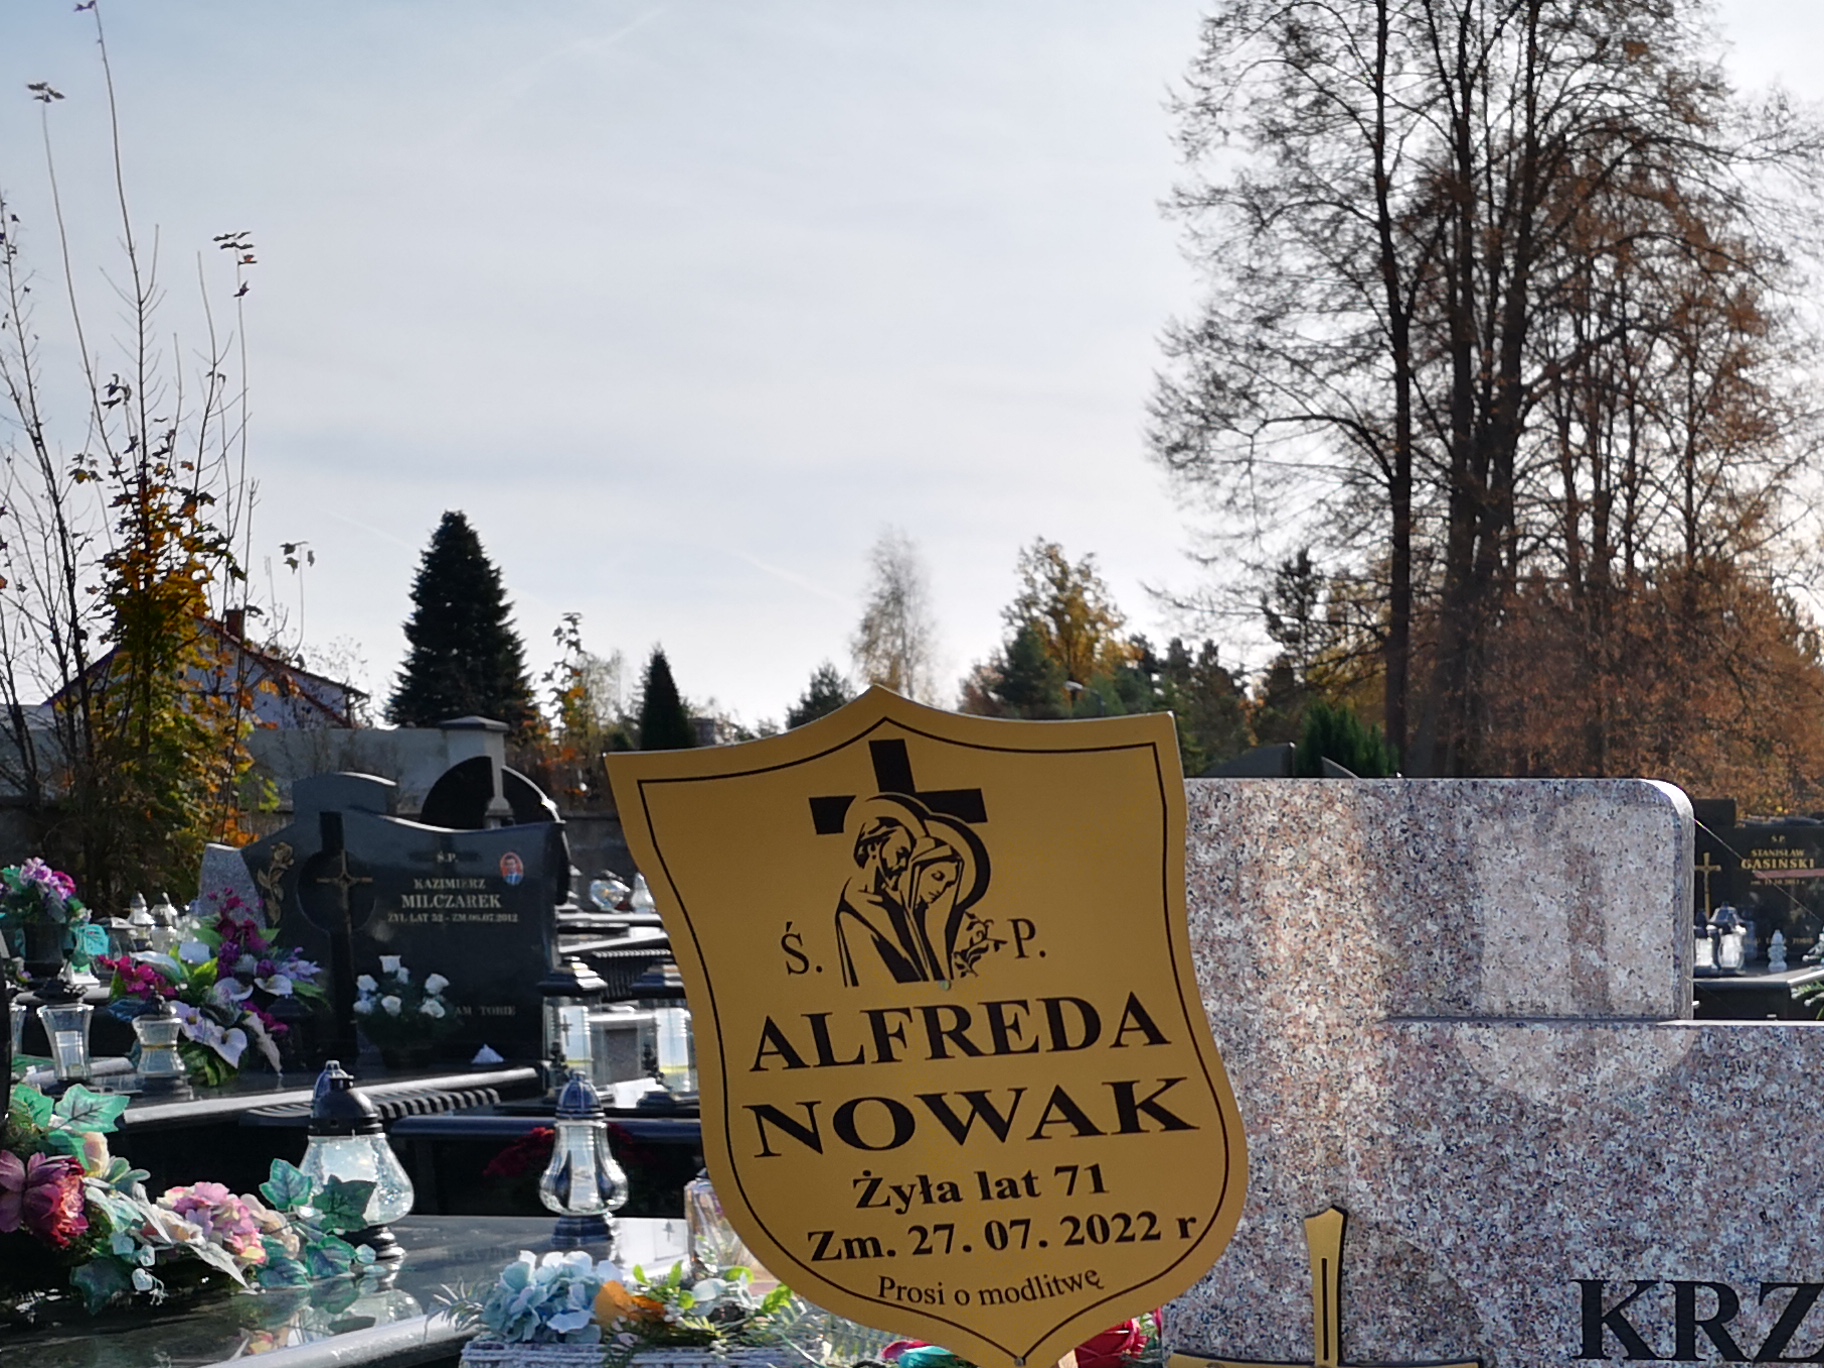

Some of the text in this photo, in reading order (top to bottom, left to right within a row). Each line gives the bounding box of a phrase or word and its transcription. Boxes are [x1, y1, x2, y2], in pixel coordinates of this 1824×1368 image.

[401, 894, 501, 909] MILCZAREK
[414, 878, 486, 890] KAZIMIERZ
[780, 917, 1047, 975] Ś. P.
[749, 990, 1172, 1073] ALFREDA
[742, 1076, 1201, 1158] NOWAK
[852, 1162, 1111, 1214] Żyła lat 71
[807, 1210, 1198, 1262] Zm. 27. 07. 2022 r
[877, 1267, 1105, 1307] Prosi o modlitwę
